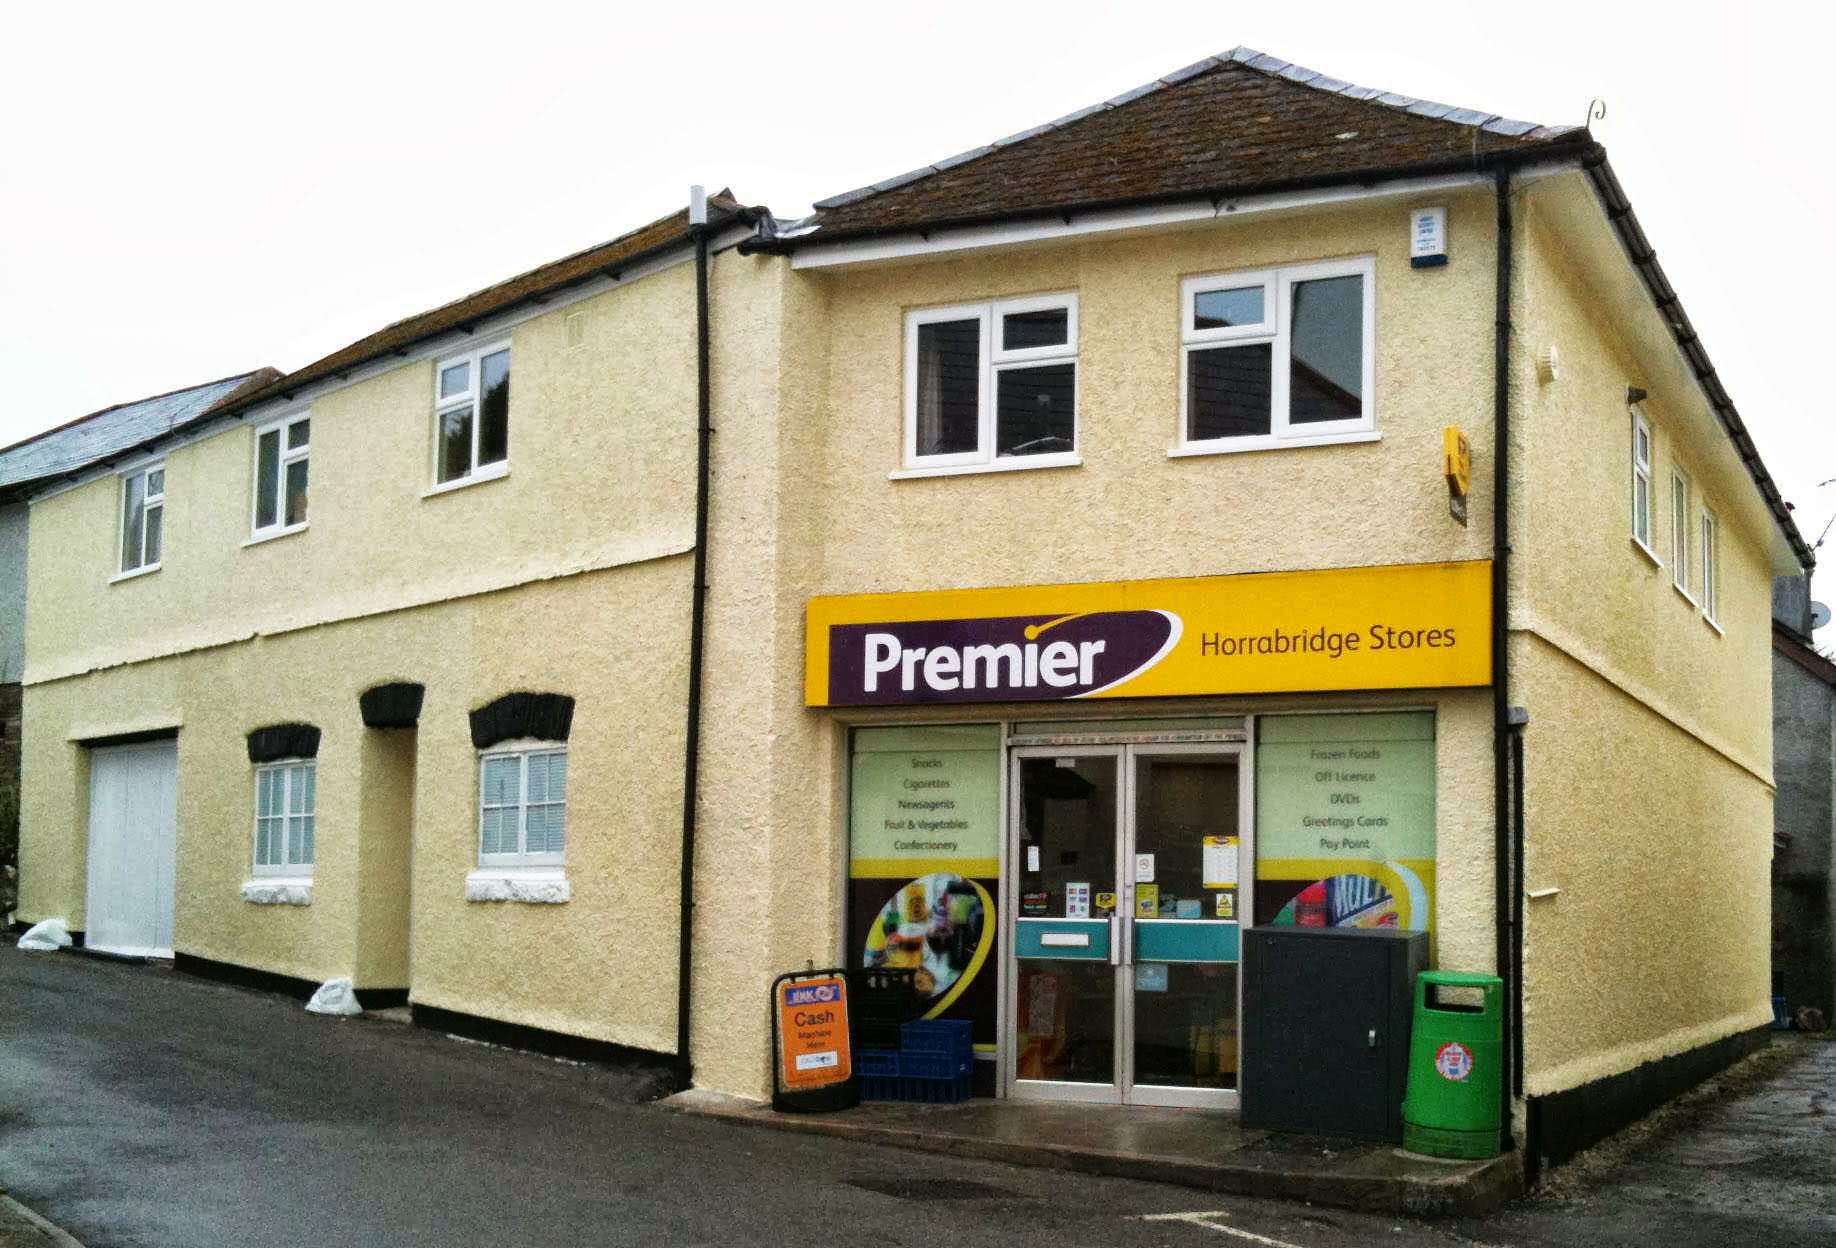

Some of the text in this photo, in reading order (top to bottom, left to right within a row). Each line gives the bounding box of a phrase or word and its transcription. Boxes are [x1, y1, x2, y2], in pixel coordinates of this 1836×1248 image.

[1201, 624, 1456, 658] Horrabridge Stores
[864, 624, 1106, 692] Premier
[1310, 748, 1381, 760] Frozen Foods
[911, 758, 943, 769] Snacks
[1314, 771, 1377, 782] Off Licence
[903, 778, 951, 792] Cigarettes
[1330, 793, 1361, 804] DVDs
[897, 800, 955, 811] Newsagents
[907, 820, 915, 830] &
[918, 820, 969, 831] Vegetables
[1302, 815, 1389, 829] Greetings Cards
[894, 840, 958, 852] Confectionery
[1320, 838, 1371, 851] Pay Point
[794, 1009, 835, 1028] Cash
